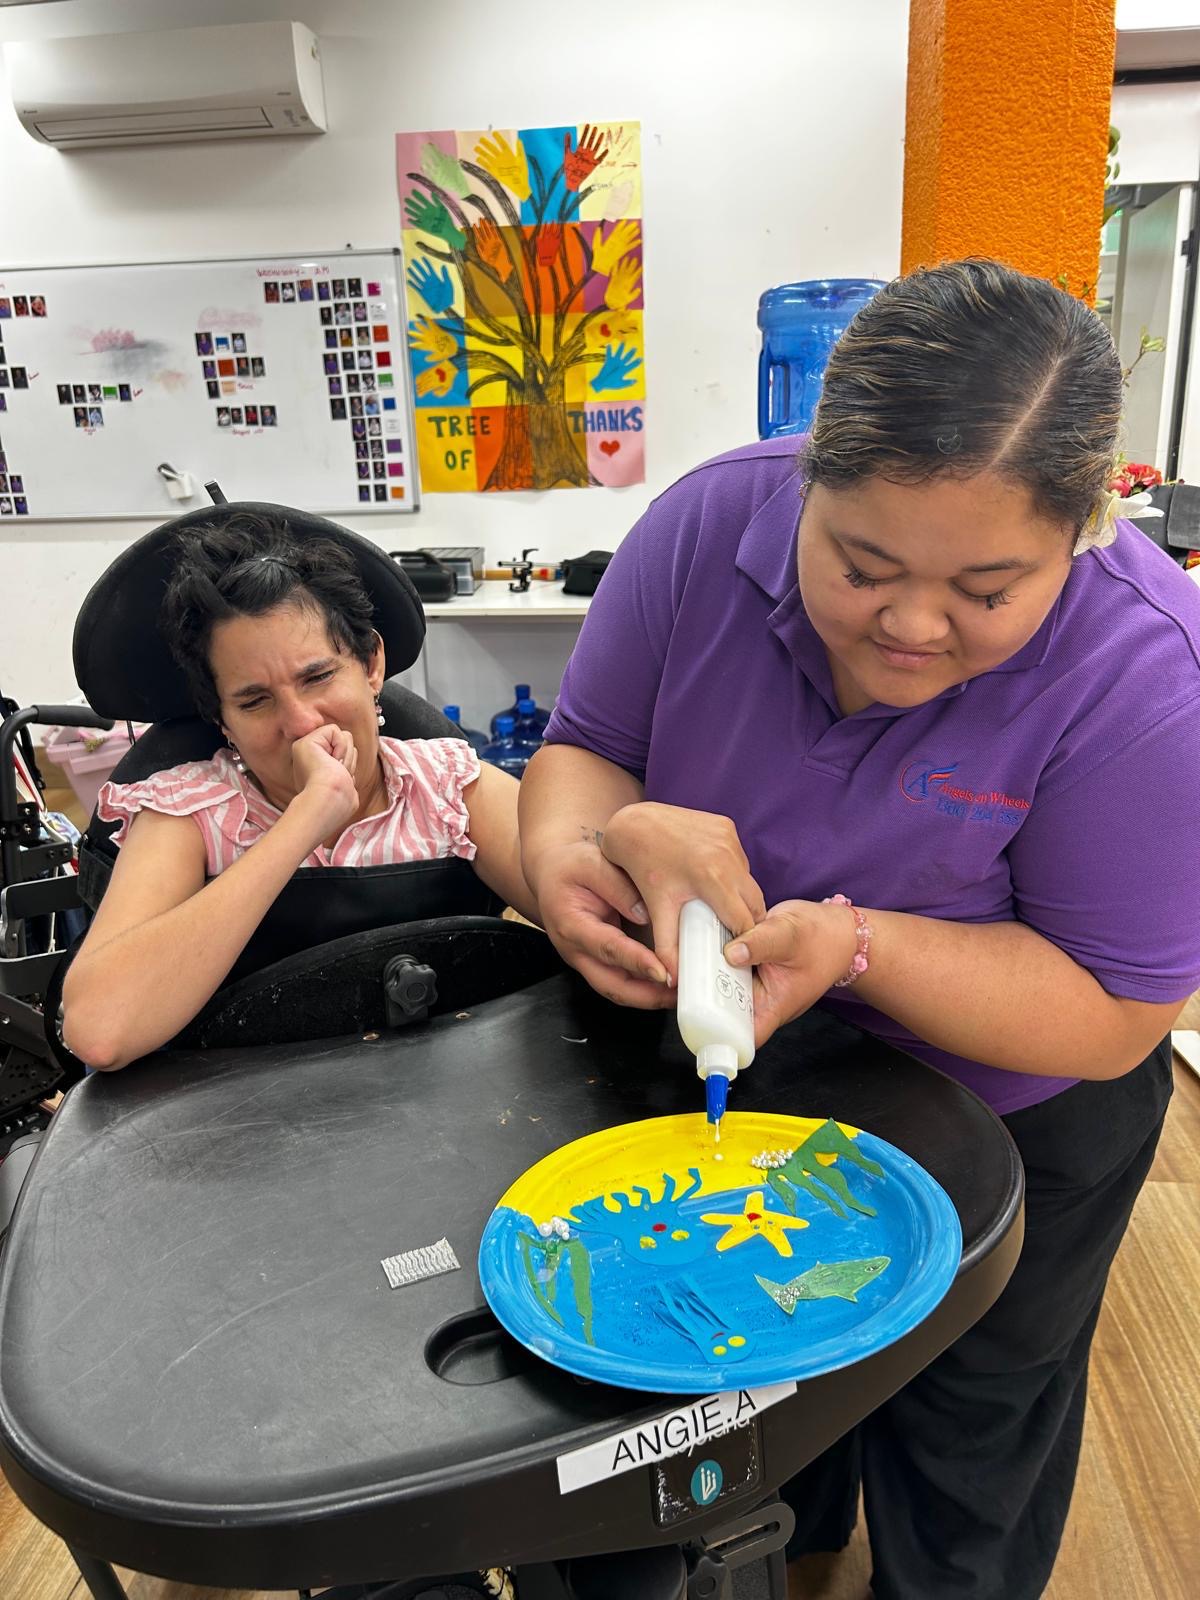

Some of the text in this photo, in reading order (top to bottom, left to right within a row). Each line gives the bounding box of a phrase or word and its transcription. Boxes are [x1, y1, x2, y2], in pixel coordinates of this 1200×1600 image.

[428, 415, 491, 438] TREE
[567, 406, 644, 433] THANKS
[444, 449, 473, 471] OF
[938, 782, 1031, 810] Angels on Wheels
